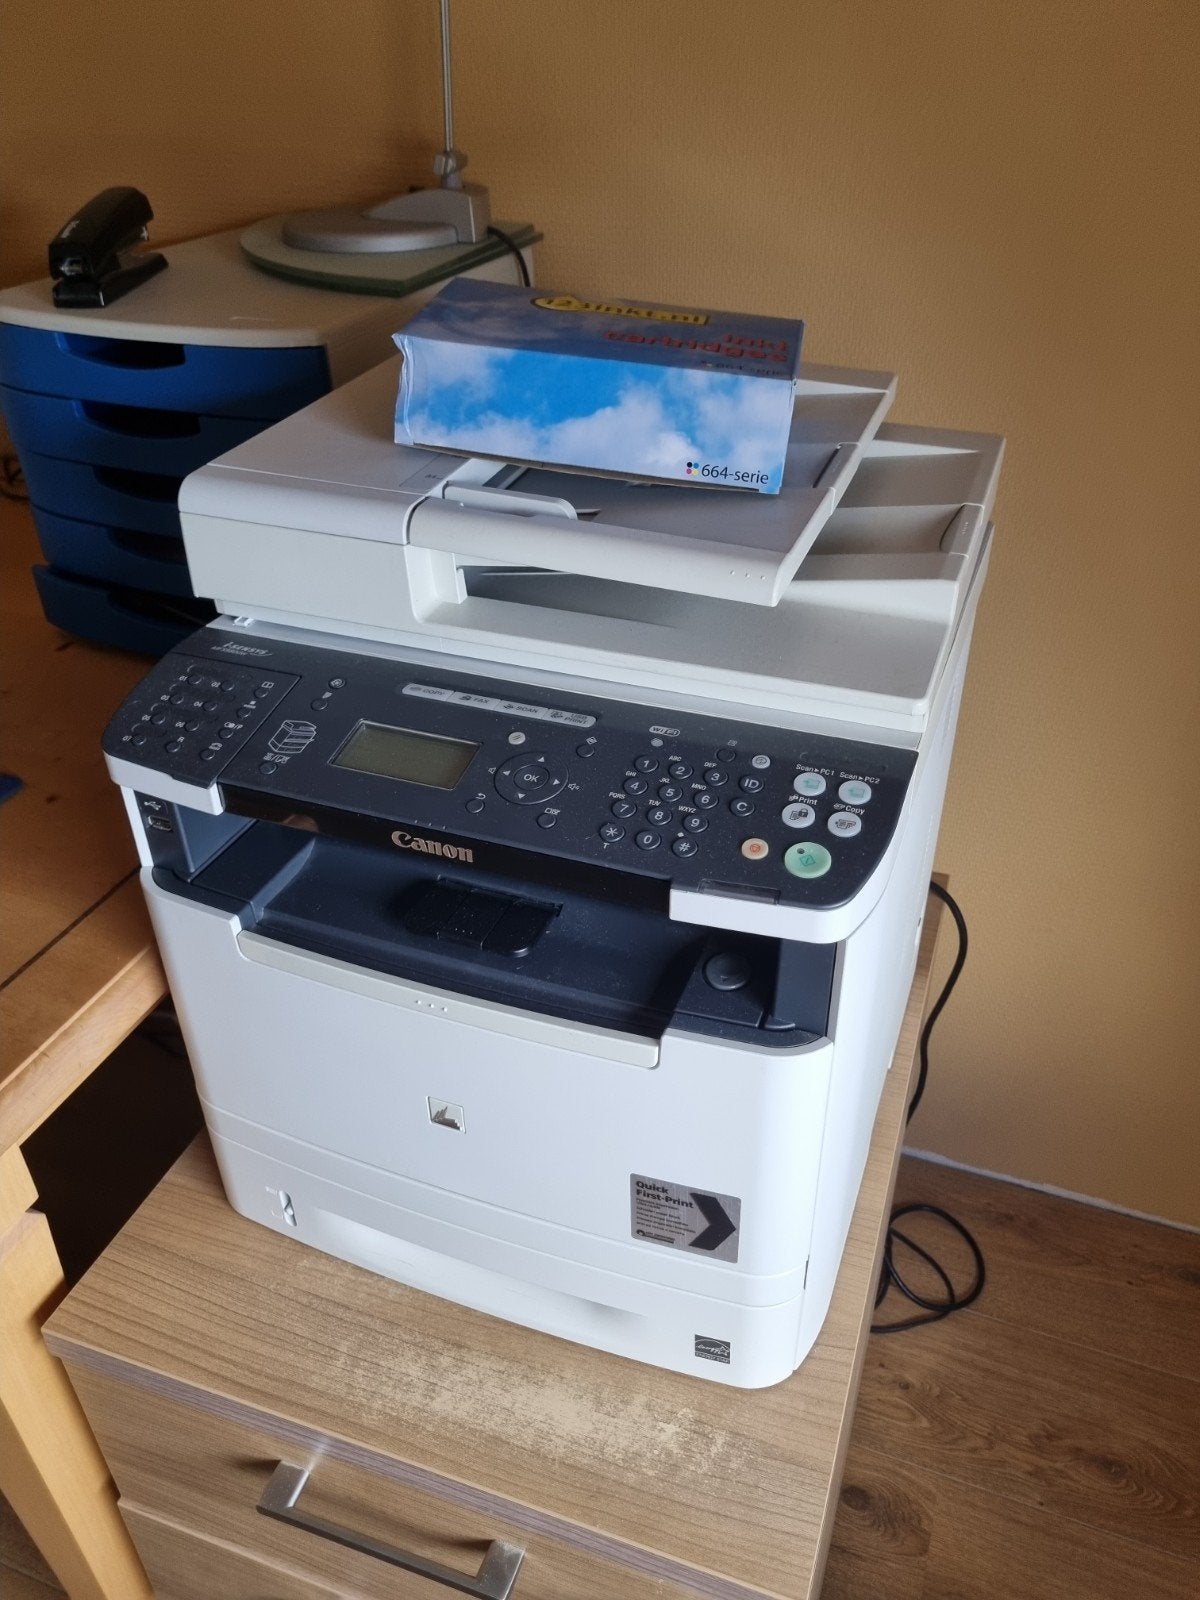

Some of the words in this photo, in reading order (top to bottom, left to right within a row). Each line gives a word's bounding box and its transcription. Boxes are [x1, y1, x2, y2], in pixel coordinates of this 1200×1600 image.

[604, 331, 788, 362] cartridges
[722, 333, 788, 351] inkt
[701, 464, 769, 485] 664-serie
[422, 688, 446, 696] COPY
[515, 705, 539, 714] SCAN
[563, 716, 588, 725] PRINT
[643, 760, 650, 768] 1
[675, 766, 686, 775] 2
[795, 763, 814, 772] Scan
[820, 768, 835, 776] PC1
[523, 773, 540, 782] OK
[711, 772, 720, 781] 3
[839, 771, 858, 780] Scan
[864, 776, 880, 785] PC2
[630, 781, 639, 790] 4
[691, 782, 707, 790] MNO
[744, 778, 760, 789] ID
[608, 791, 626, 799] PQRS
[665, 788, 676, 797] 5
[701, 795, 710, 804] 6
[798, 796, 818, 806] Print
[620, 803, 629, 813] 7
[678, 805, 697, 813] WXYZ
[736, 802, 748, 811] C
[845, 805, 866, 815] Copy
[654, 811, 664, 820] 8
[690, 818, 700, 827] 9
[643, 834, 652, 844] 0
[391, 830, 474, 863] Canon
[636, 1180, 669, 1194] Quick
[636, 1188, 694, 1208] First-Print
